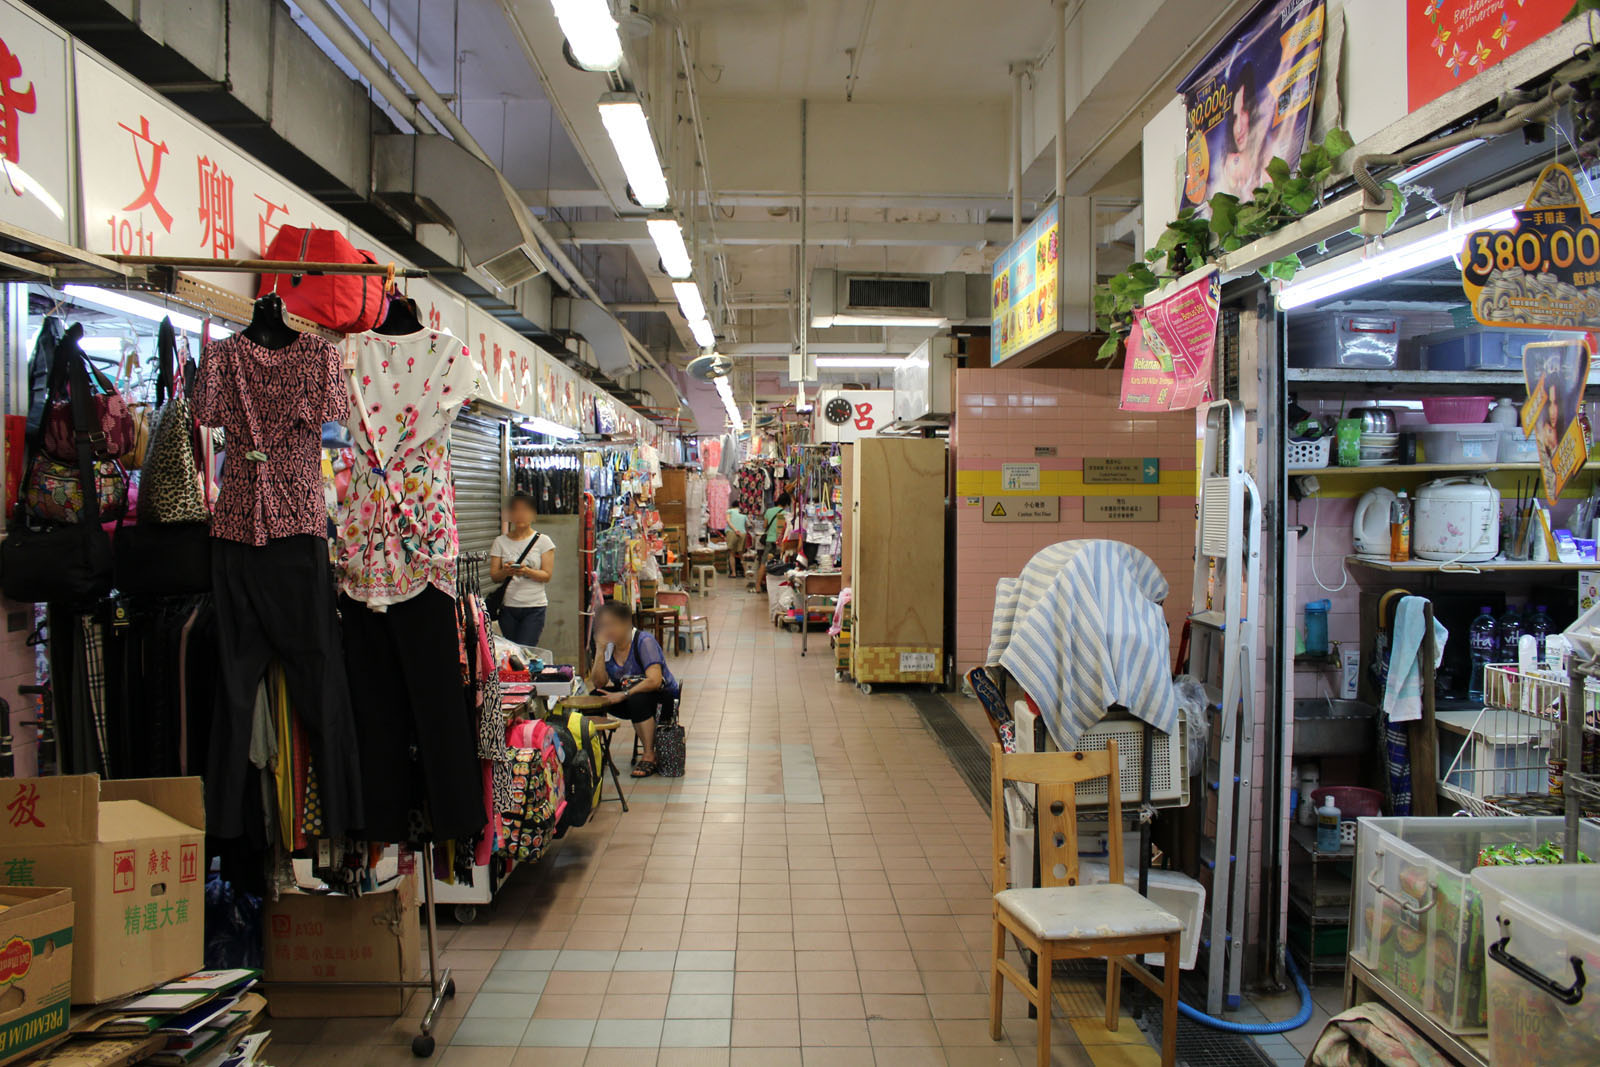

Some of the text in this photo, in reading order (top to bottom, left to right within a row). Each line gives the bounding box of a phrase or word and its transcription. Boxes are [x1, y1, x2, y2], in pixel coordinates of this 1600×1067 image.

[1189, 84, 1226, 130] 80,000
[117, 115, 326, 259] 文卿百
[107, 213, 154, 257] 1011
[1522, 211, 1566, 225] 一手帶走
[854, 402, 875, 431] 呂
[1504, 630, 1520, 645] vit
[6, 783, 46, 828] 放
[147, 848, 171, 876] 廣發
[124, 899, 190, 936] 精選大蕉
[9, 1007, 63, 1049] PREMIUM
